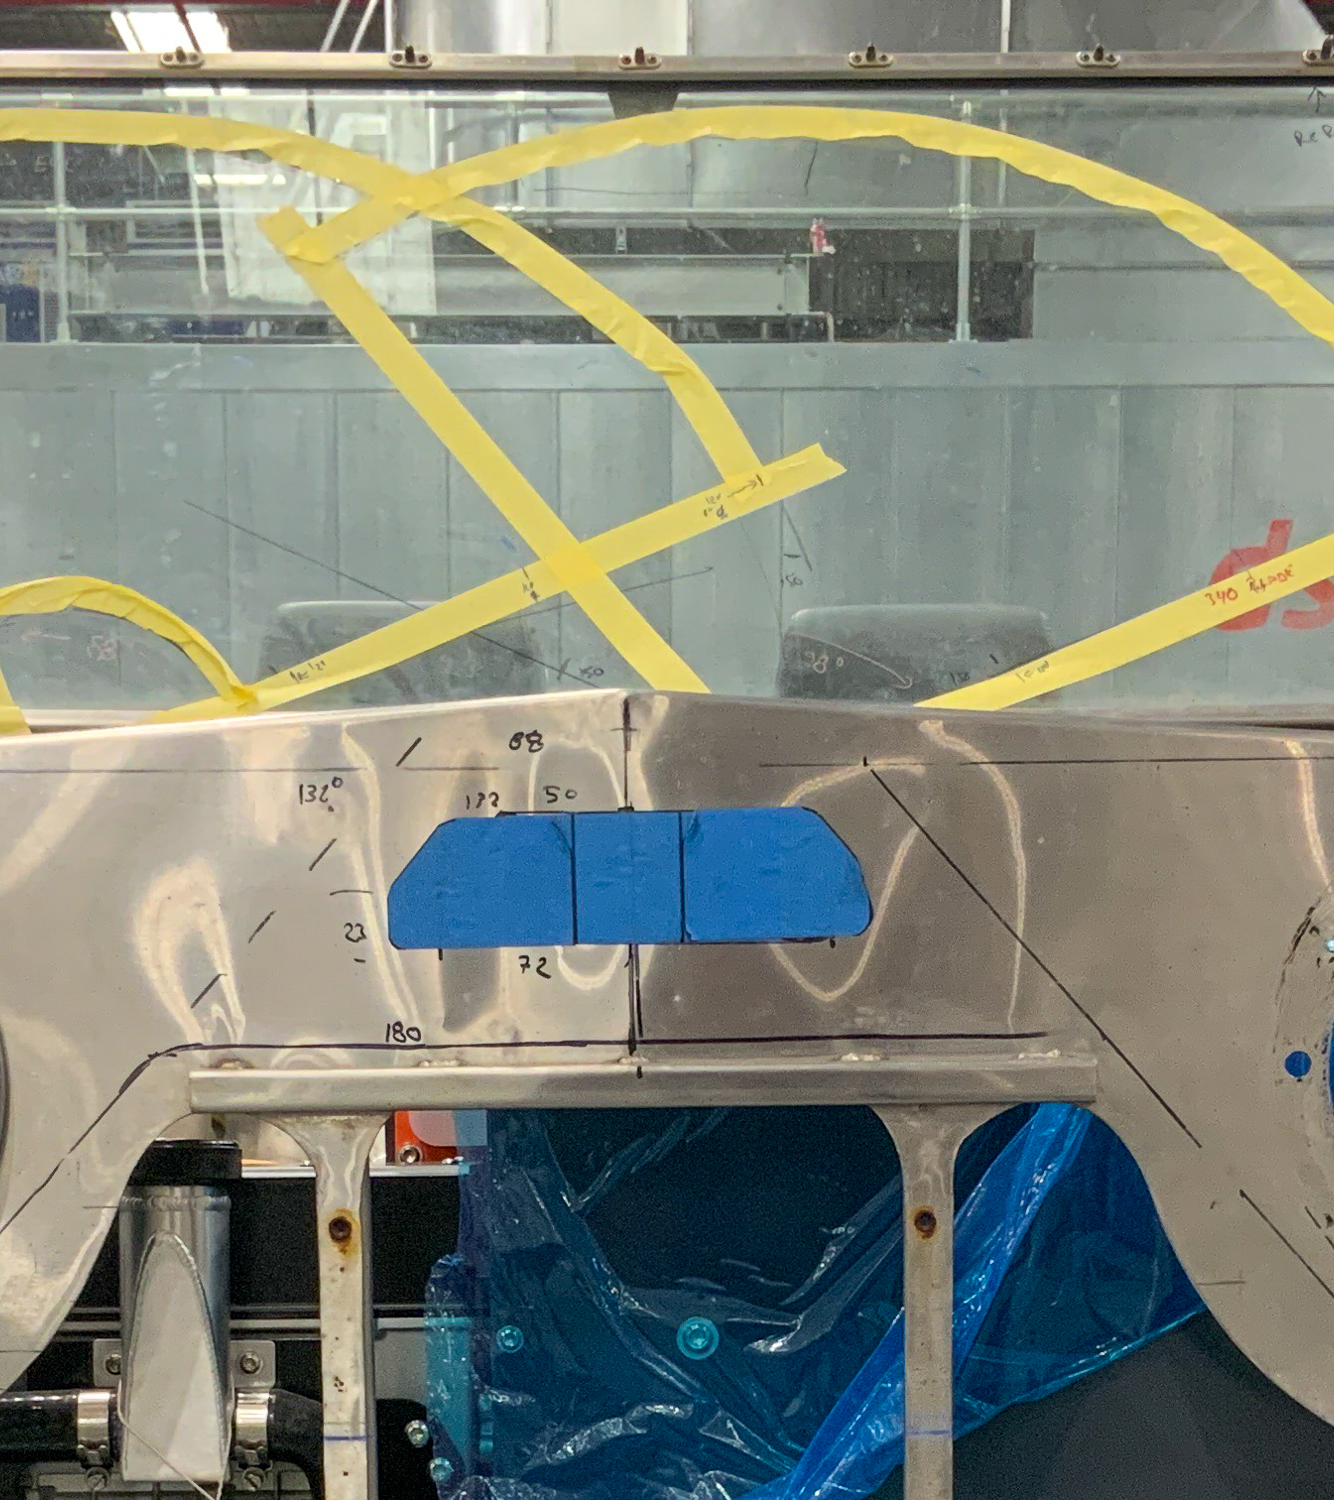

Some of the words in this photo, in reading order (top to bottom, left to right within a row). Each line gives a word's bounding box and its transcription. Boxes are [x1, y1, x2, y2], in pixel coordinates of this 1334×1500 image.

[344, 923, 367, 943] 23
[518, 955, 552, 979] 72
[385, 1021, 422, 1043] 180
